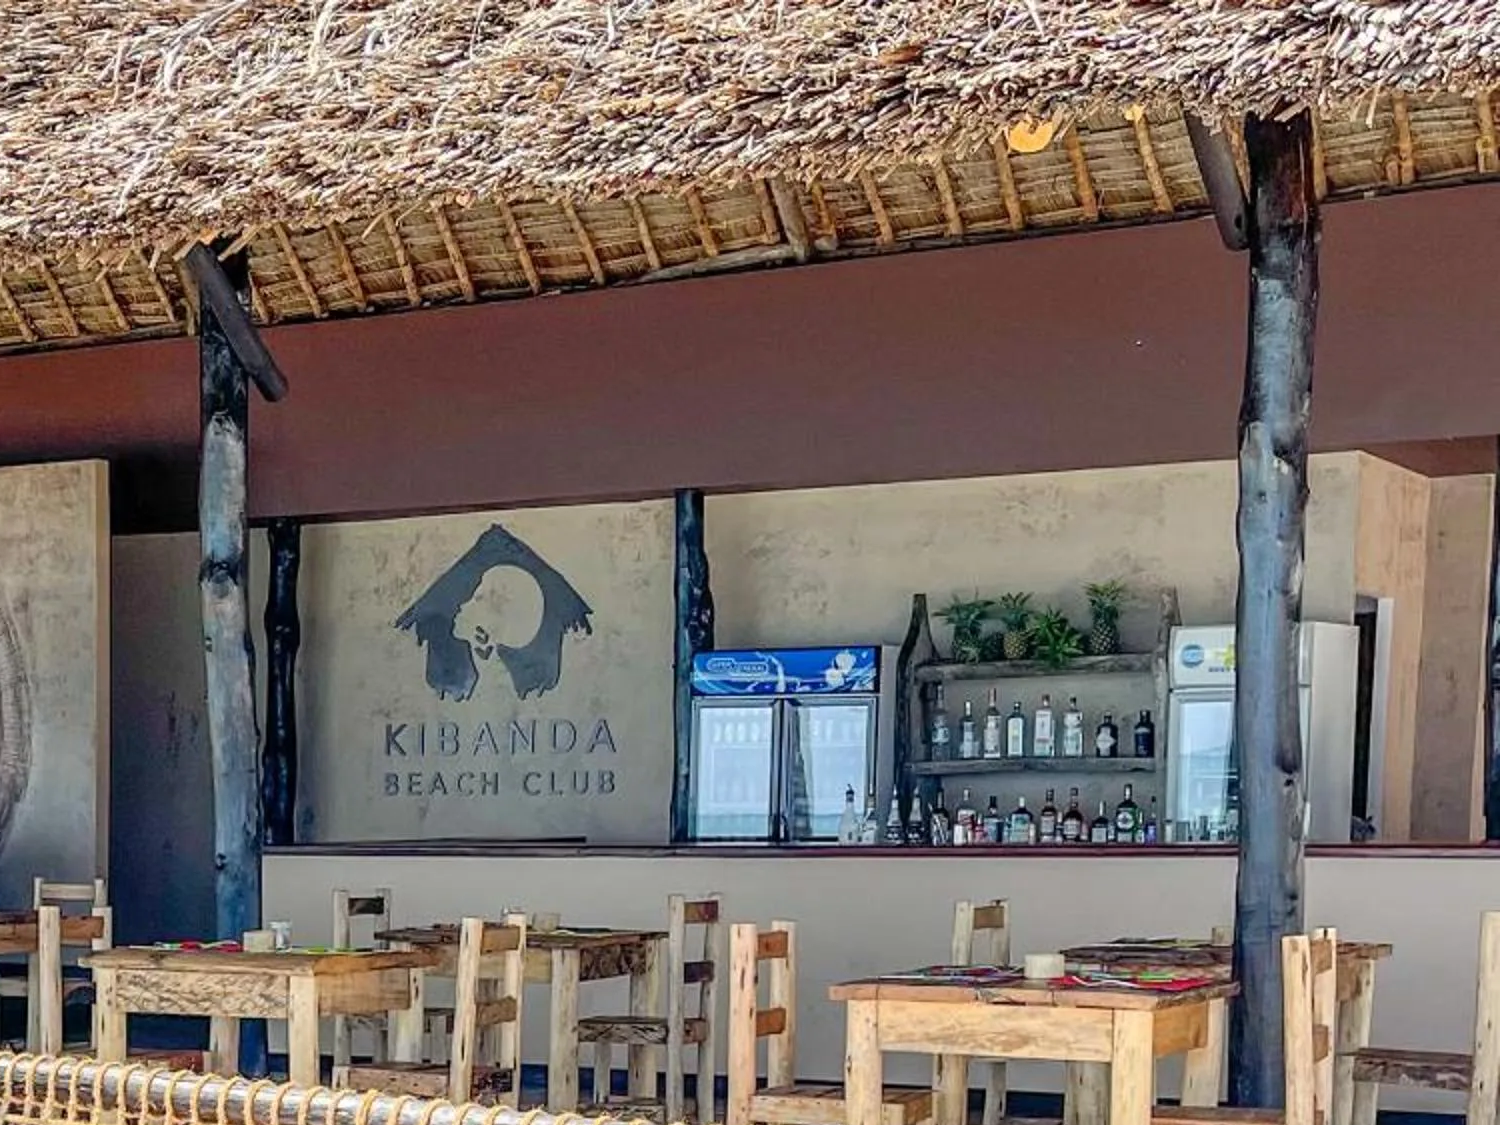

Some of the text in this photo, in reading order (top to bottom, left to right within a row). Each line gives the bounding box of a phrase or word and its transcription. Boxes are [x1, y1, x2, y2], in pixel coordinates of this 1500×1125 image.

[384, 719, 617, 757] KIBANDA
[384, 770, 616, 797] BEACH CLUB
